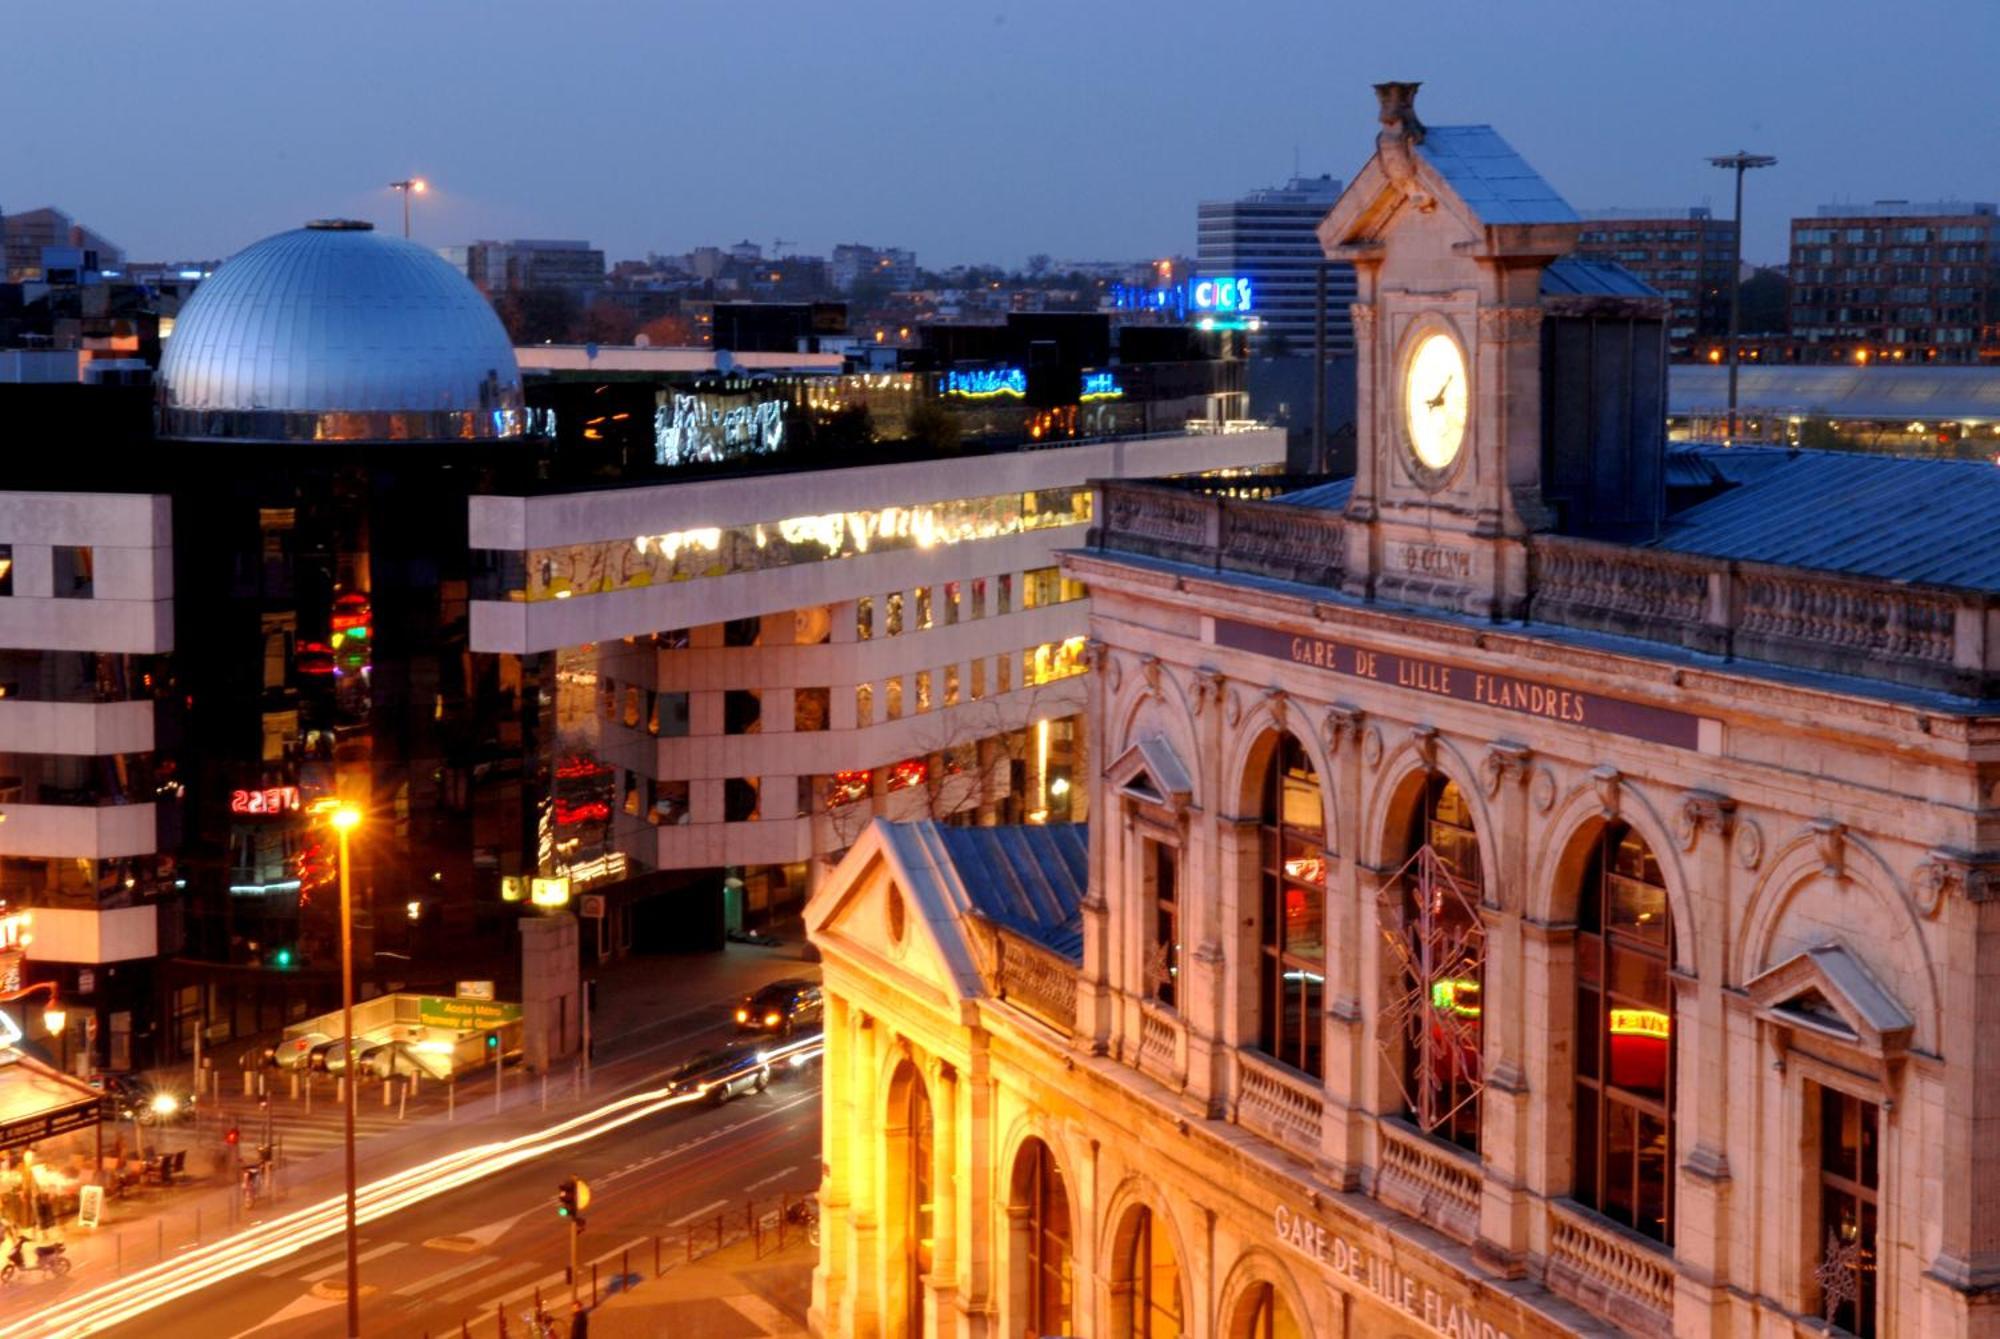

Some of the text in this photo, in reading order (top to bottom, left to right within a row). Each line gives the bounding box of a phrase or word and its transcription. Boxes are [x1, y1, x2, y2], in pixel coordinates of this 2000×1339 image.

[1291, 637, 1585, 722] GARE DE LILLE FLANDRES
[1274, 1204, 1511, 1339] GARE DE LILLE FLAN
